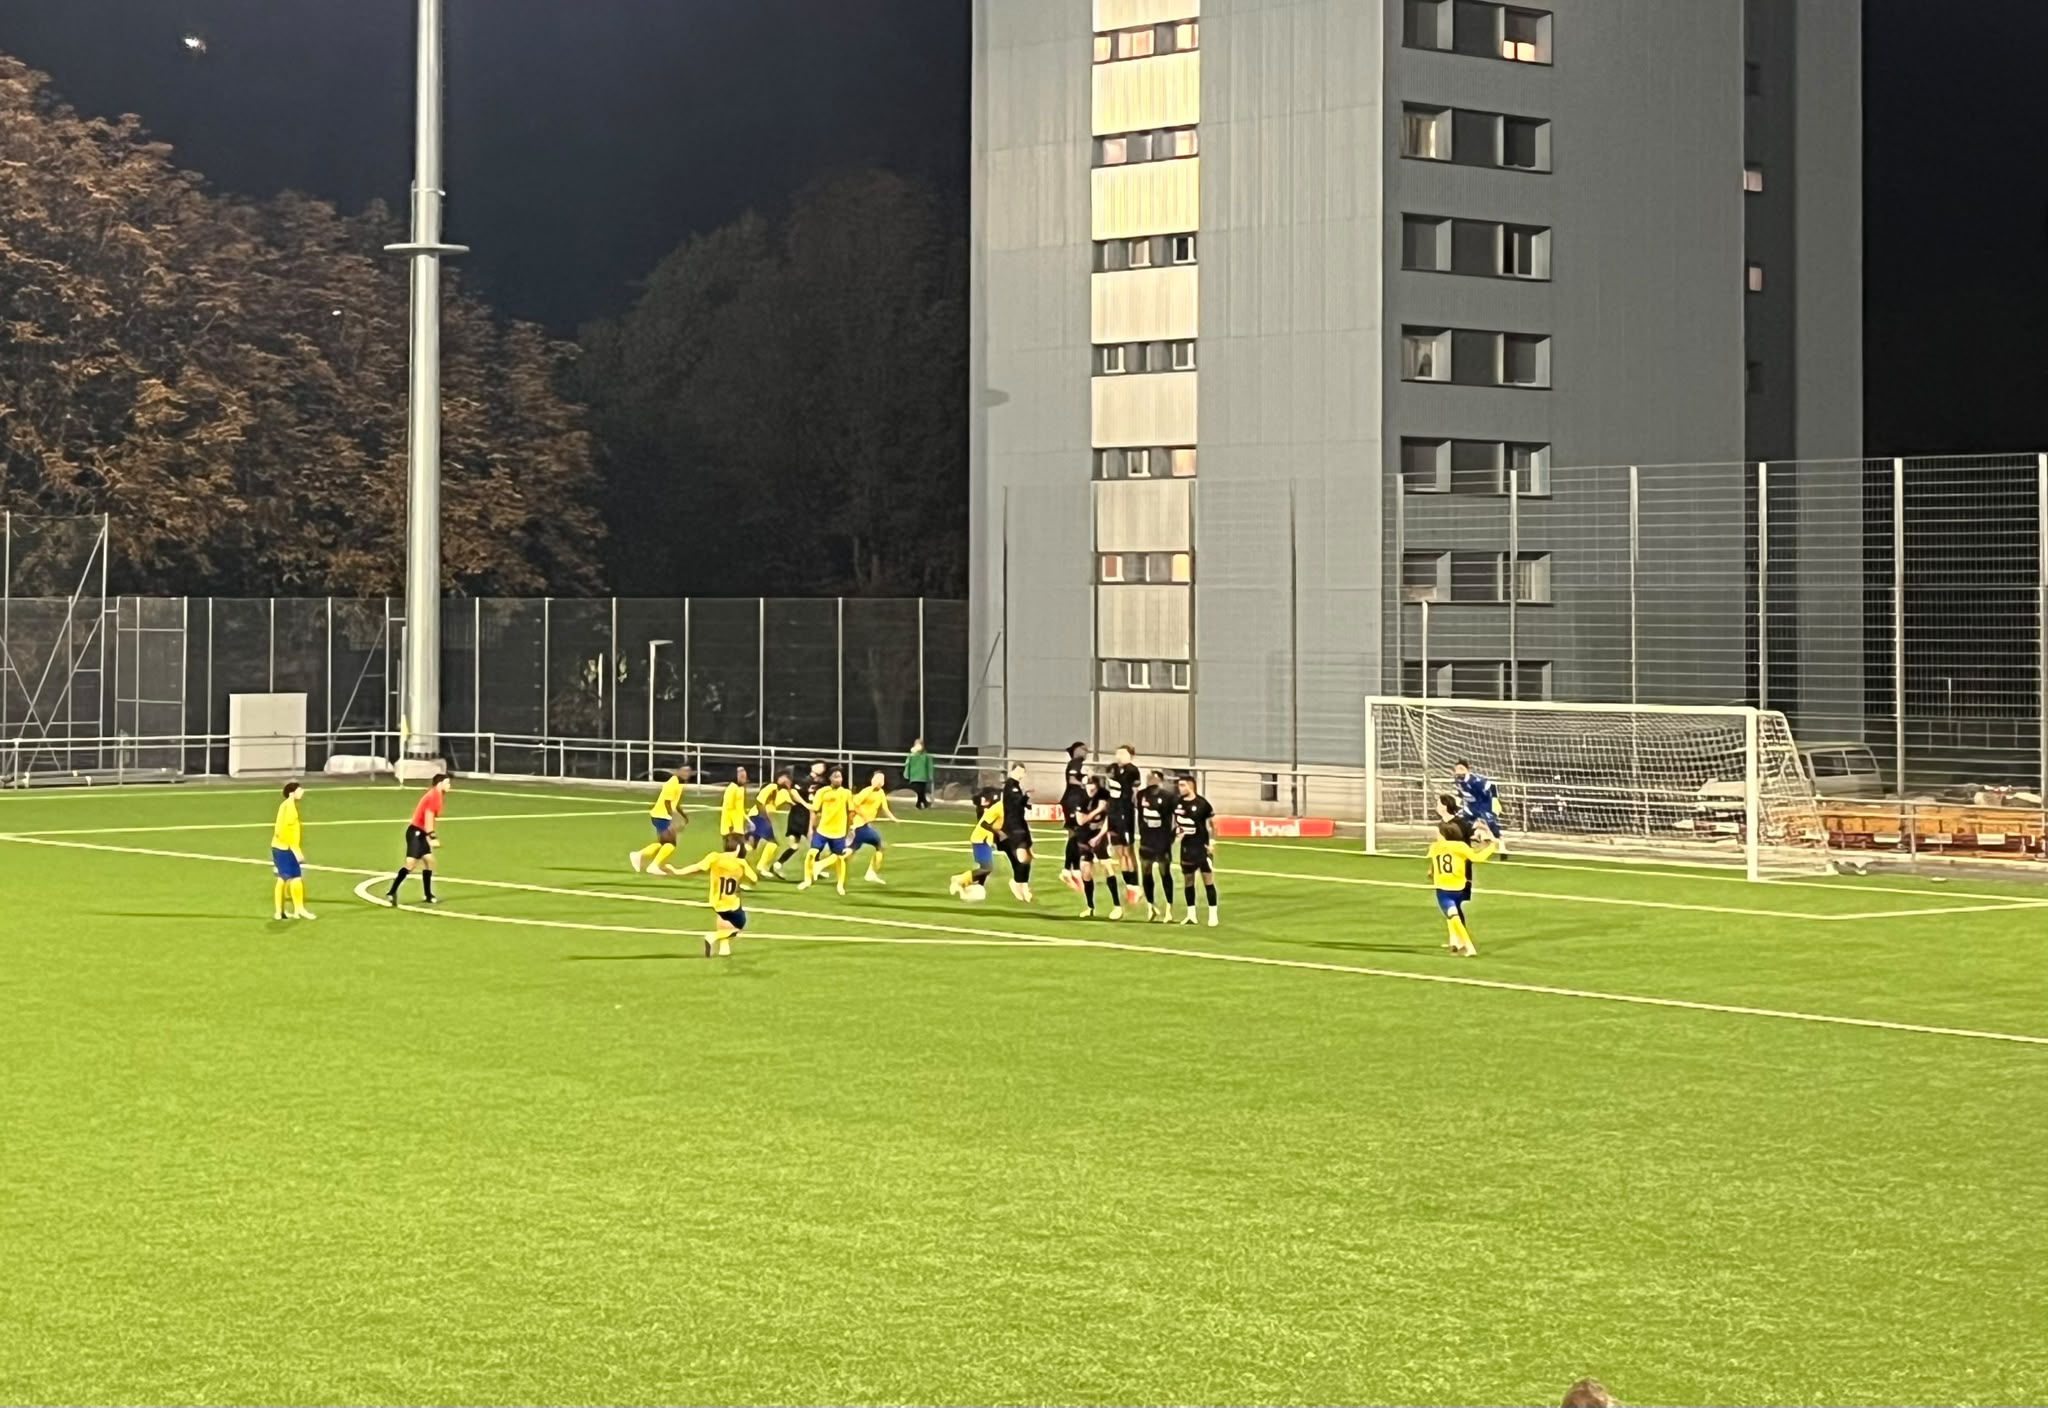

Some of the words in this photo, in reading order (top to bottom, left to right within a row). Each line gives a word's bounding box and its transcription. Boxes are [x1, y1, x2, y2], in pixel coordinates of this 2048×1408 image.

[1250, 819, 1301, 837] Hoval
[1436, 853, 1453, 875] 18
[719, 877, 737, 896] 10
